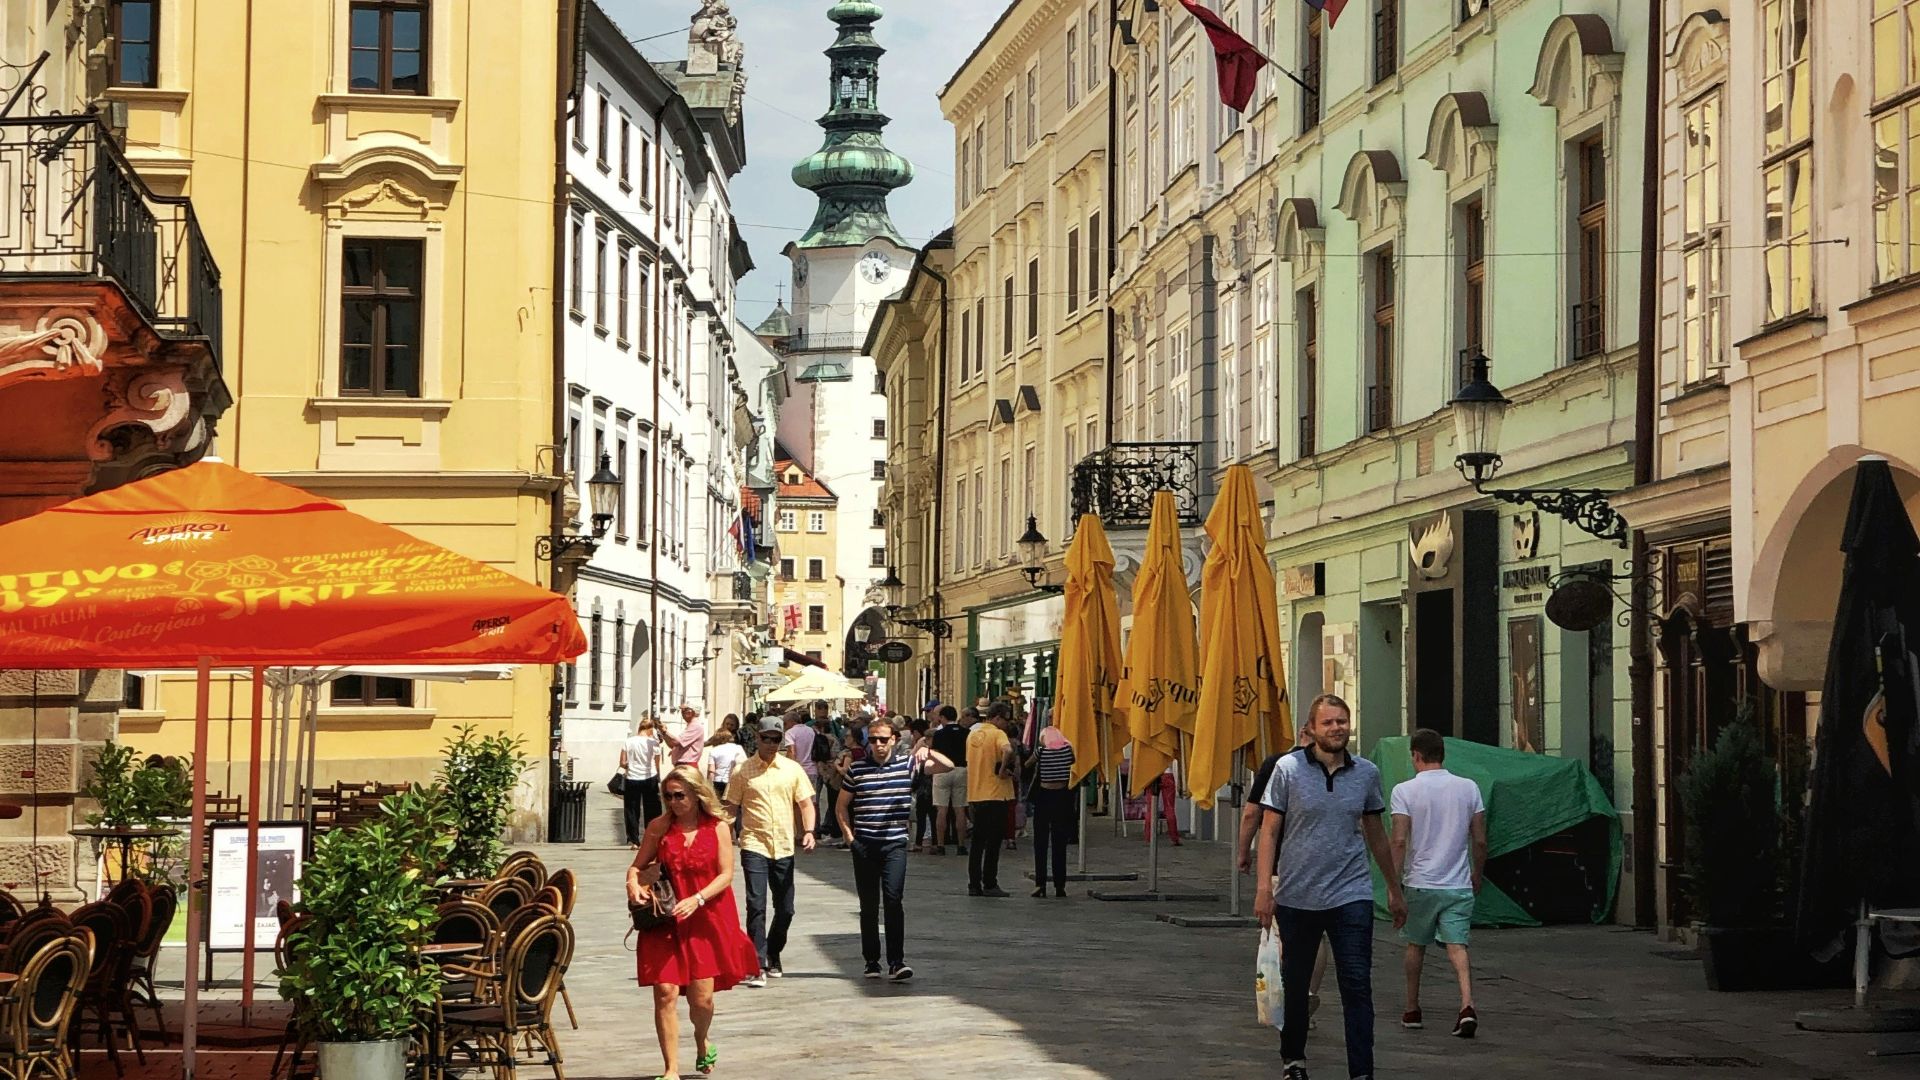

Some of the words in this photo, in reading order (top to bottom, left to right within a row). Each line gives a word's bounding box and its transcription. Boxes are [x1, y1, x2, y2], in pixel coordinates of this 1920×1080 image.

[128, 523, 232, 540] APEROL
[142, 531, 214, 544] SPRITZ
[282, 548, 388, 563] SPONTANEOUS
[405, 583, 466, 592] PADOVA
[214, 581, 398, 619] SPRITZ
[33, 604, 97, 631] ITALIAN
[472, 615, 511, 631] APEROL
[94, 613, 207, 643] Contagious
